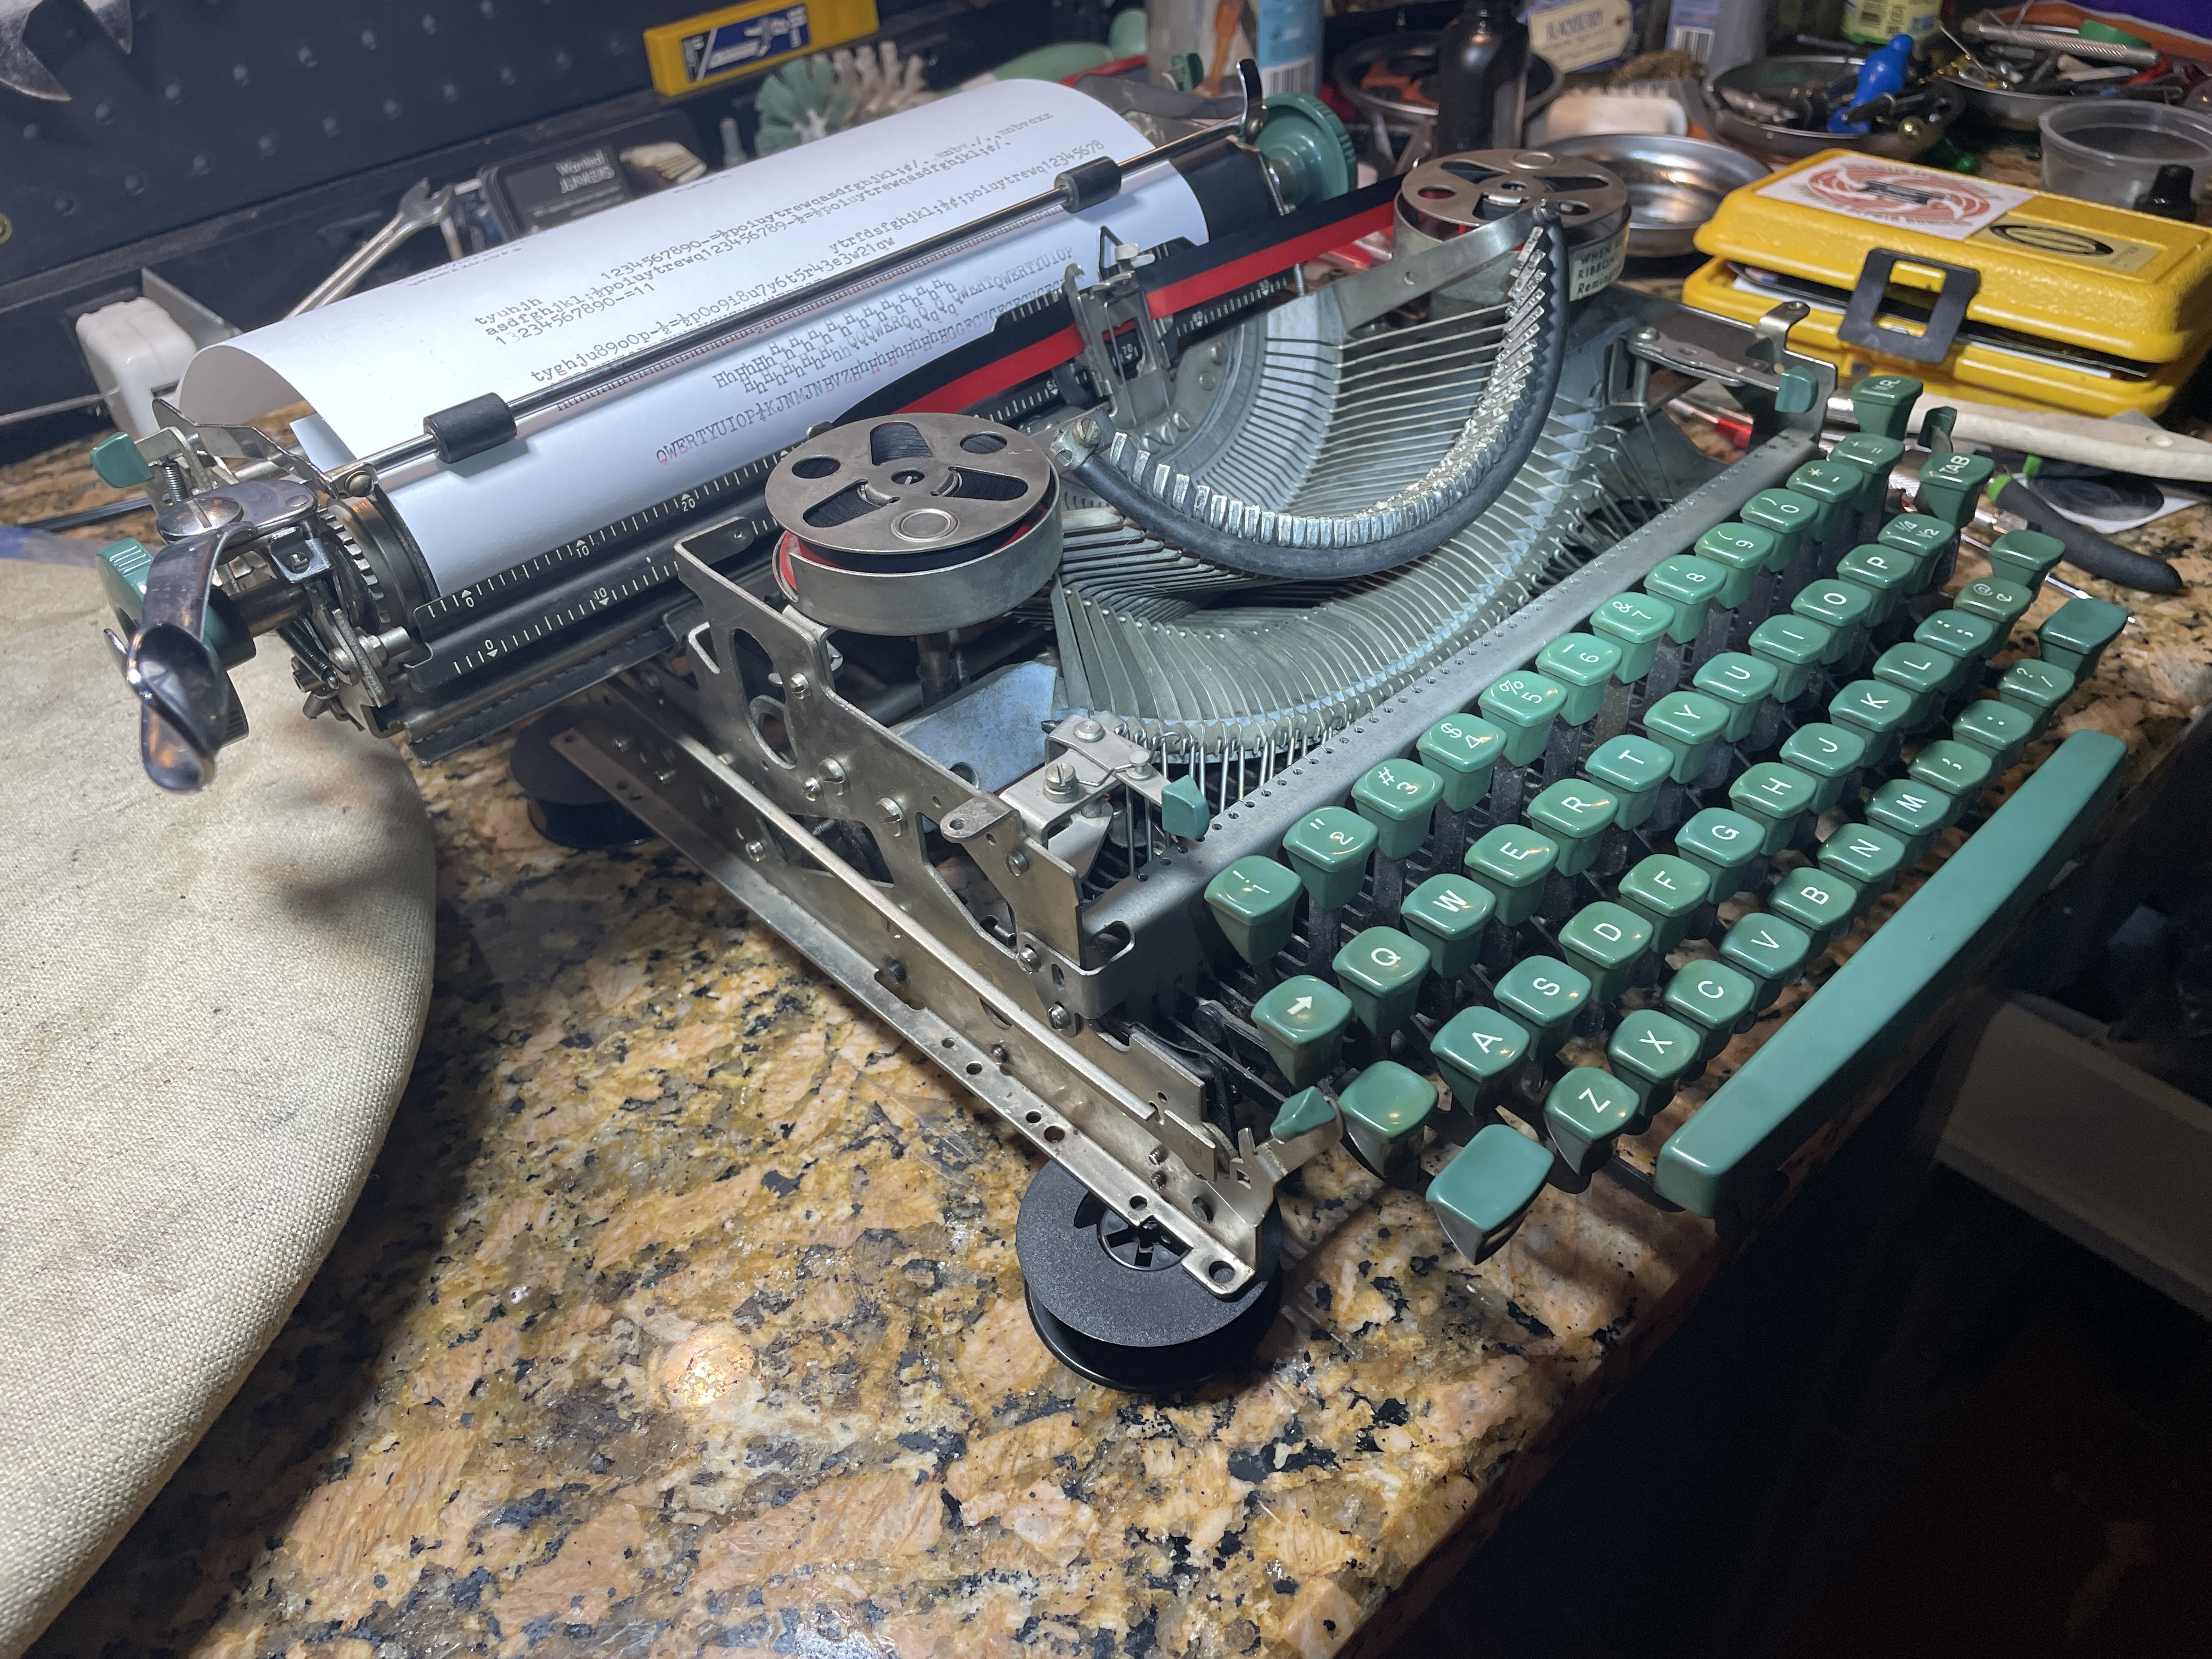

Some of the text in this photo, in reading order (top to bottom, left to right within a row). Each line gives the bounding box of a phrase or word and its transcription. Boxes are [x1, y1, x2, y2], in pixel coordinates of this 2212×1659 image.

[1939, 455, 1970, 475] TAB
[681, 498, 696, 512] 20
[576, 546, 590, 558] 10
[1866, 556, 1888, 570] P
[1686, 572, 1706, 583] 8
[466, 597, 475, 607] 0
[594, 588, 607, 600] 10
[485, 640, 493, 650] 0
[1579, 651, 1599, 663] 6
[1903, 660, 1932, 671] L
[1724, 665, 1751, 680] U
[1521, 691, 1542, 704] 5
[1860, 692, 1889, 710] K
[1673, 704, 1701, 719] Y
[1818, 736, 1838, 754] J
[1618, 749, 1645, 764] T
[1396, 781, 1419, 795] 3
[1761, 776, 1793, 796] H
[1561, 795, 1592, 813] R
[1895, 794, 1928, 812] M
[1329, 831, 1355, 845] 2
[1711, 825, 1741, 840] G
[1499, 842, 1530, 861] E
[1849, 838, 1881, 858] N
[1653, 870, 1677, 890] F
[1432, 889, 1468, 913] W
[1799, 885, 1830, 905] B
[1593, 922, 1622, 943] D
[1750, 929, 1780, 949] V
[1370, 947, 1401, 967] Q
[1532, 977, 1561, 996] S
[1697, 980, 1725, 999] C
[1472, 1031, 1503, 1054] A
[1639, 1030, 1673, 1054] X
[1578, 1087, 1611, 1113] Z
